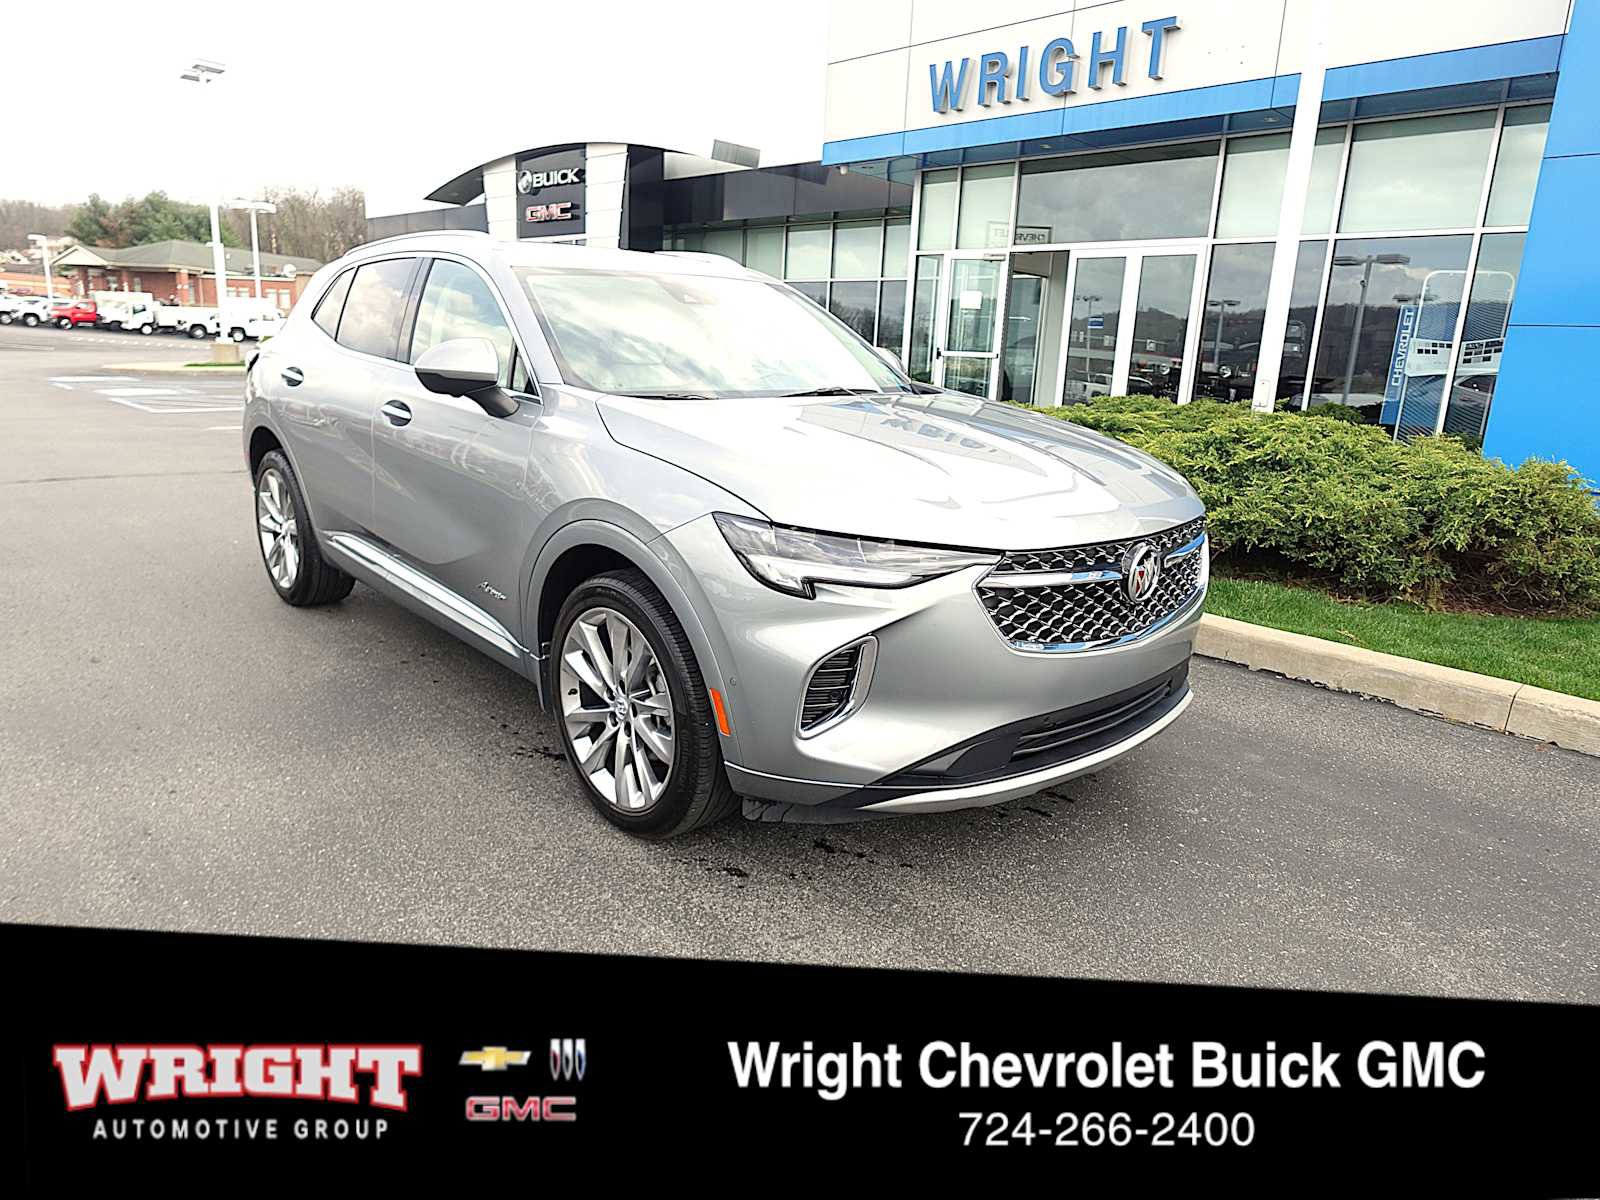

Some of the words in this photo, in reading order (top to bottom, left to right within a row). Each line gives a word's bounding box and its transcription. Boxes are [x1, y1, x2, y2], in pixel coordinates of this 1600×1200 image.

[929, 15, 1182, 114] WRIGHT
[532, 167, 580, 188] BUICK
[526, 201, 572, 222] GMC
[1391, 309, 1415, 386] CHEVROLET
